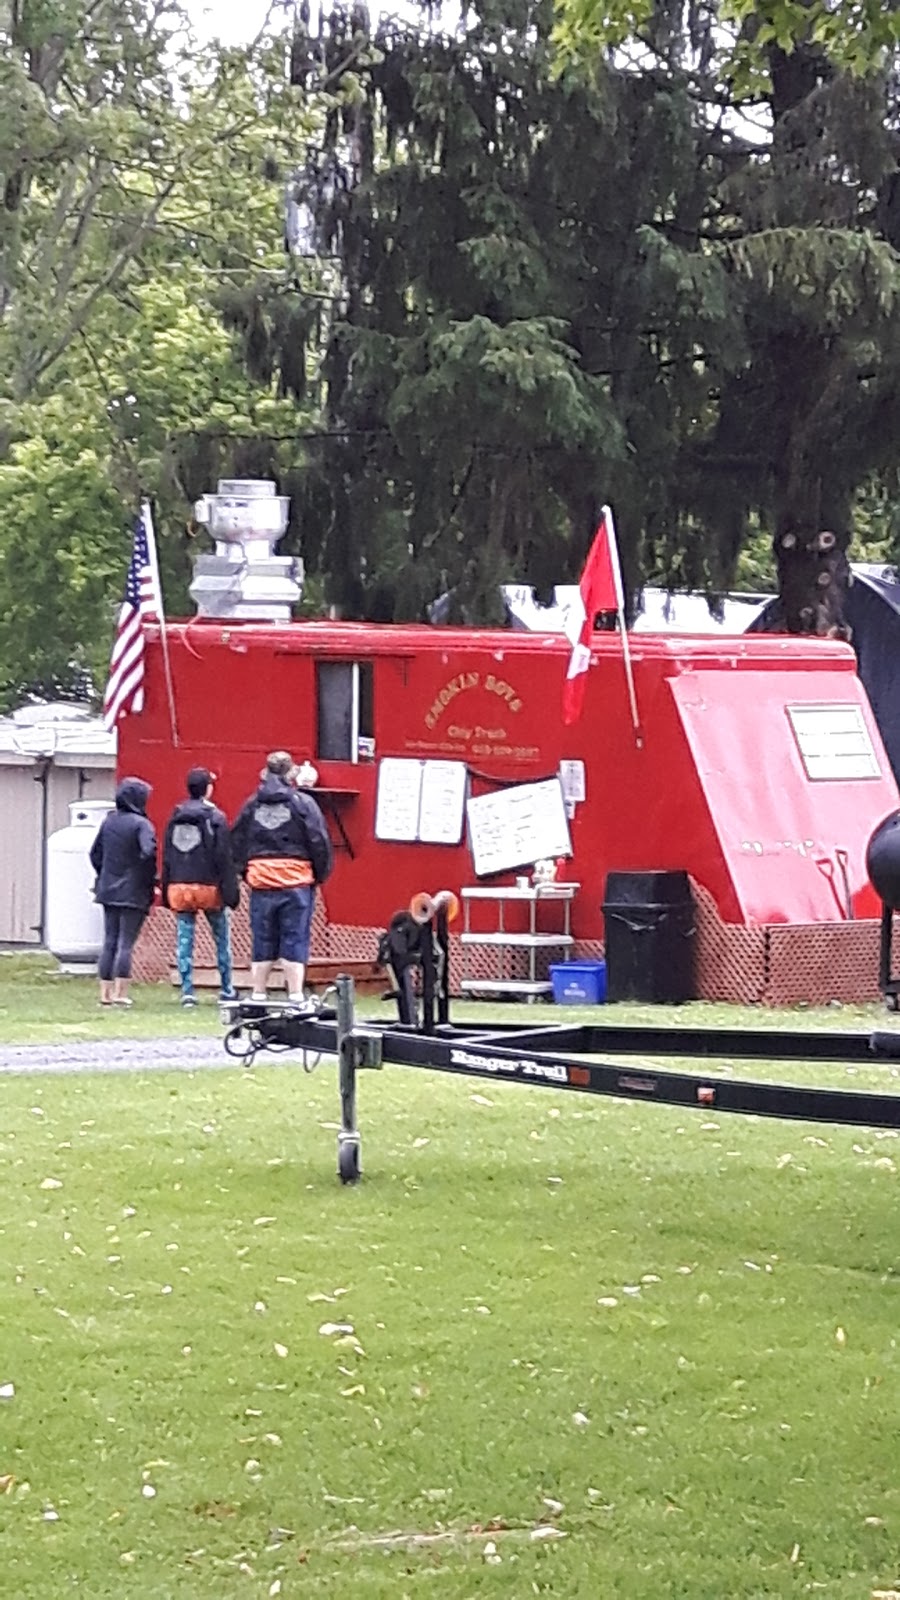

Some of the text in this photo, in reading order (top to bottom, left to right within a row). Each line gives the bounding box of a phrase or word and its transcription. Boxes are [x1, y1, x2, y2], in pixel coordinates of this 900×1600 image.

[424, 672, 523, 730] SMOKIN BOYS
[450, 1049, 518, 1071] Ranger
